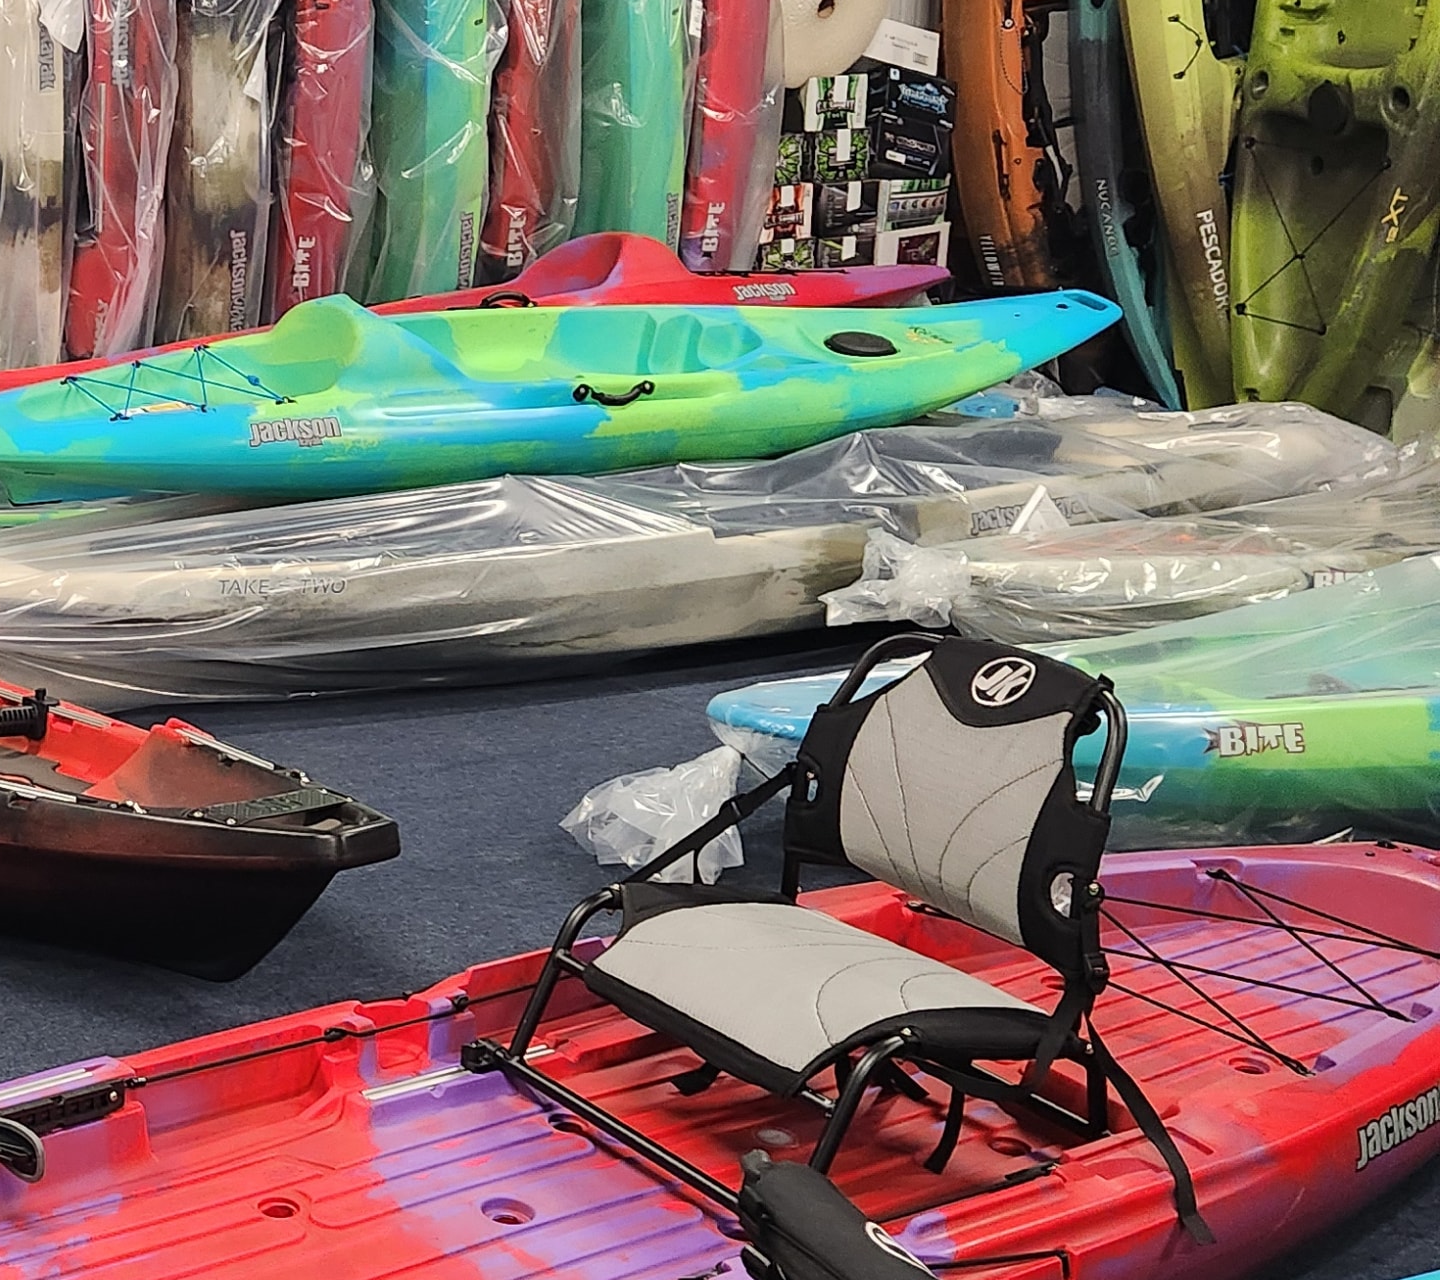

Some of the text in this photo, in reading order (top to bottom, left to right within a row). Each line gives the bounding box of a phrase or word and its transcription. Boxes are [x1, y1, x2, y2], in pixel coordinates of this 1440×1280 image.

[702, 202, 726, 252] BITE
[293, 235, 316, 287] BITE
[218, 578, 346, 595] TAKE TWO
[1219, 722, 1305, 757] BITE
